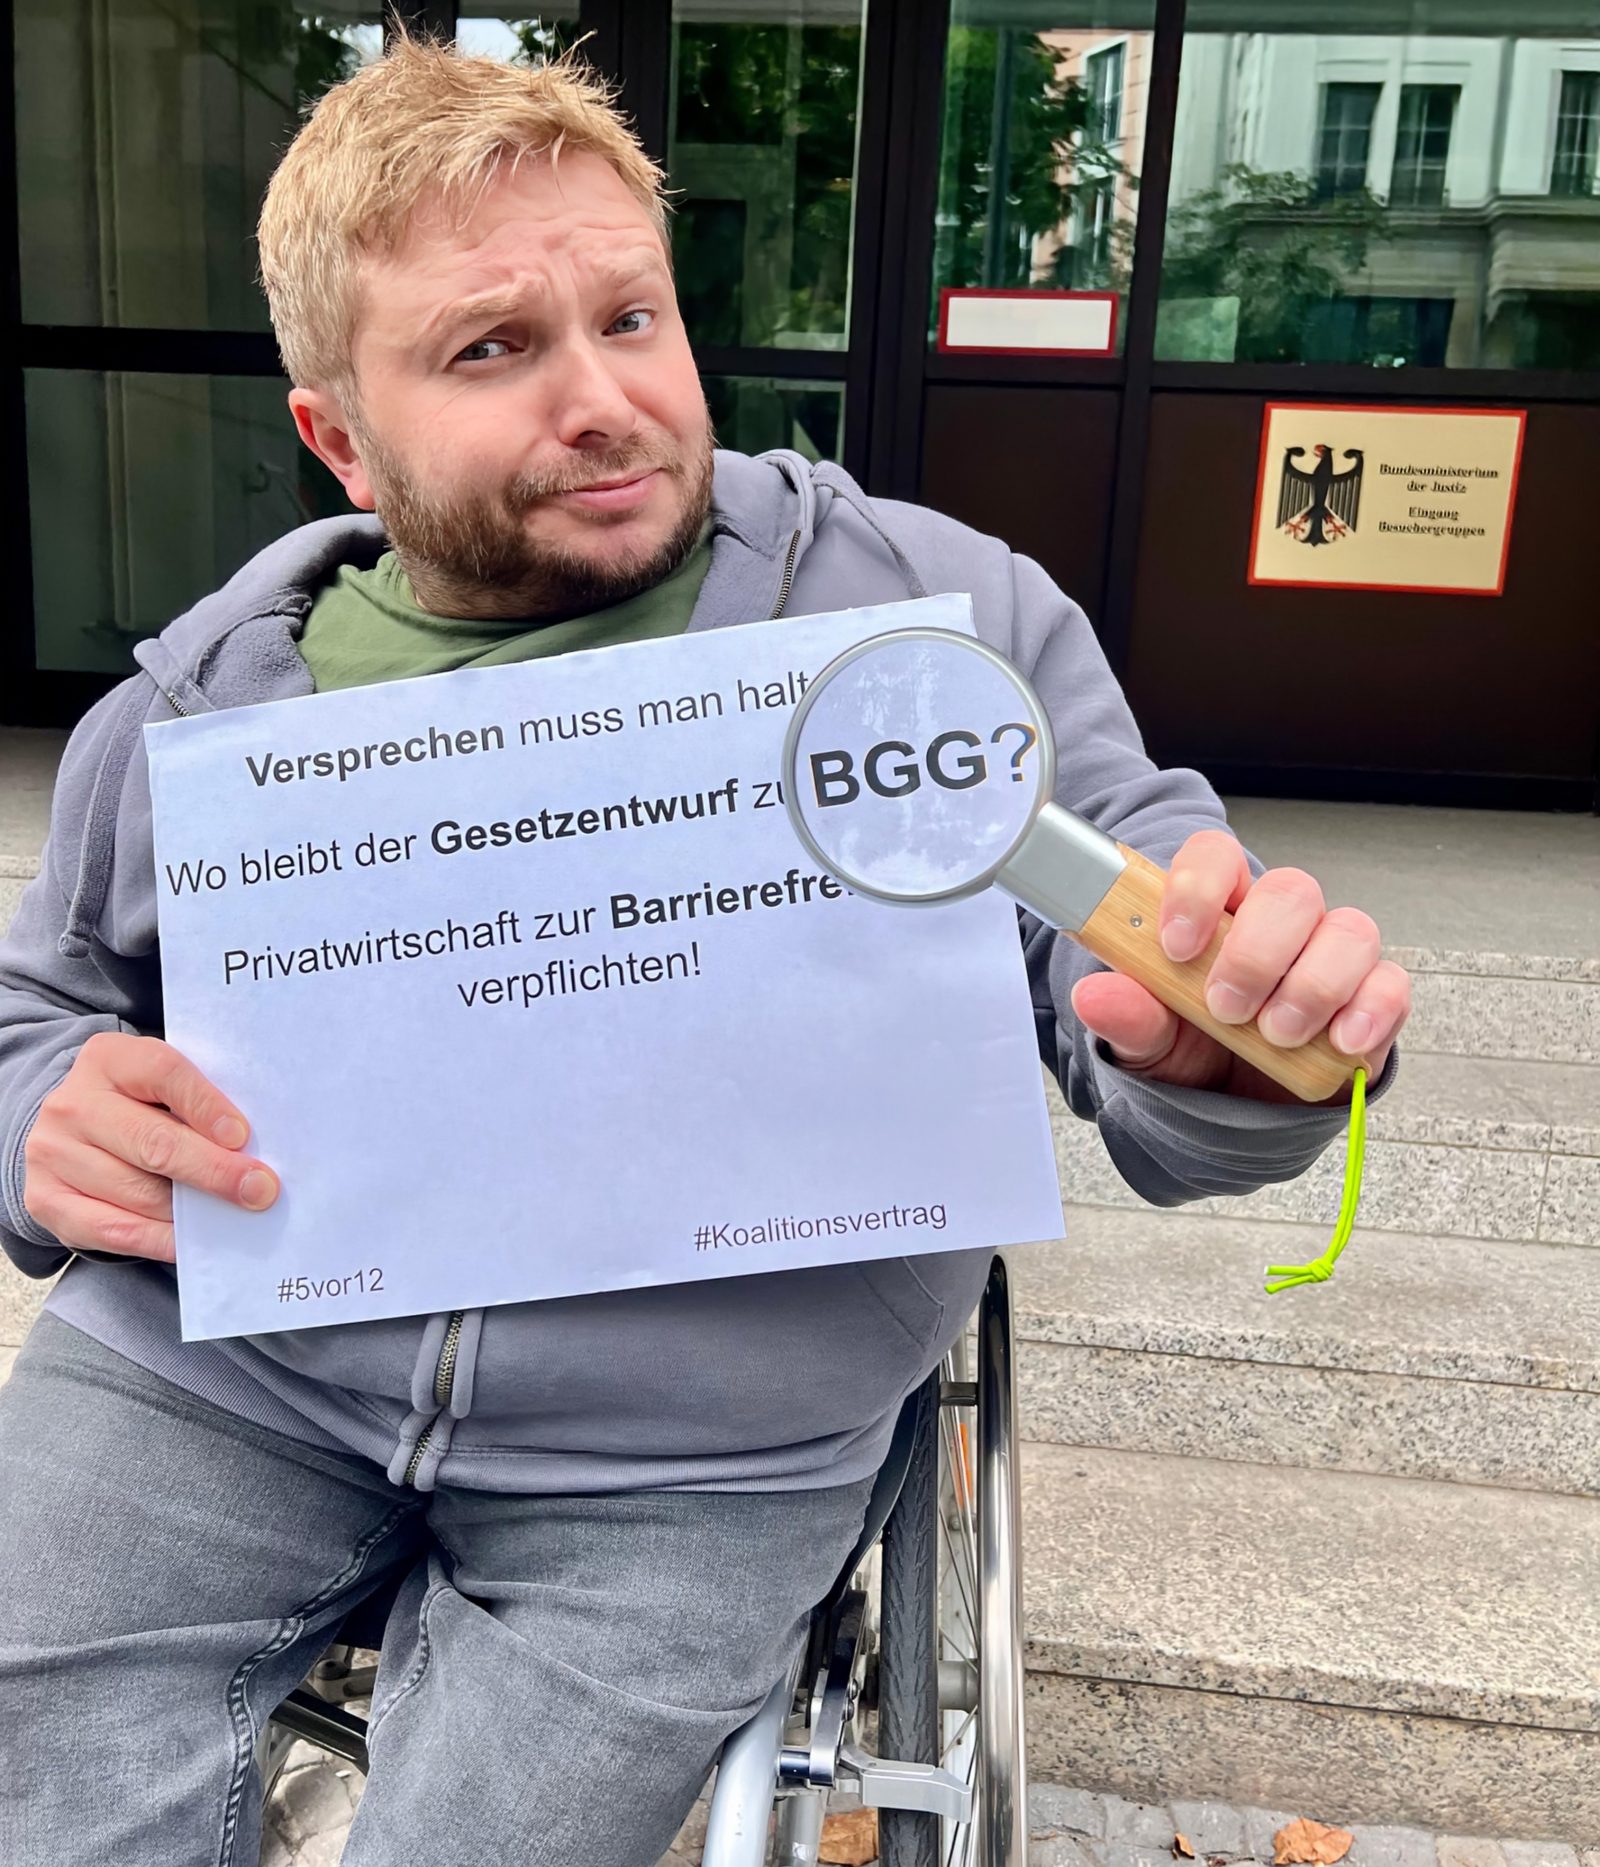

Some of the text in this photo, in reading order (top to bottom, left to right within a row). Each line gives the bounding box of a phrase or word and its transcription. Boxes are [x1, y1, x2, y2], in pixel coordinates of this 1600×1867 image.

[1379, 463, 1499, 479] Bundesministerium
[1406, 481, 1467, 494] der Justiz
[1378, 521, 1486, 539] Besuchergruppen
[1408, 506, 1459, 521] Eingang
[245, 722, 505, 787] Versprechen
[519, 707, 624, 746] muss
[638, 691, 724, 728] man
[808, 721, 1038, 808] BGG?
[165, 858, 227, 896] Wo
[240, 839, 343, 886] bleibt
[354, 831, 418, 867] der
[430, 777, 741, 855] Gesetzentwurf
[223, 868, 853, 985] Privatwirtschaft zur Barrierefre
[456, 940, 701, 1009] verpflichten!
[693, 1203, 947, 1252] #Koalitionsvertrag
[277, 1267, 385, 1304] #5vor12
